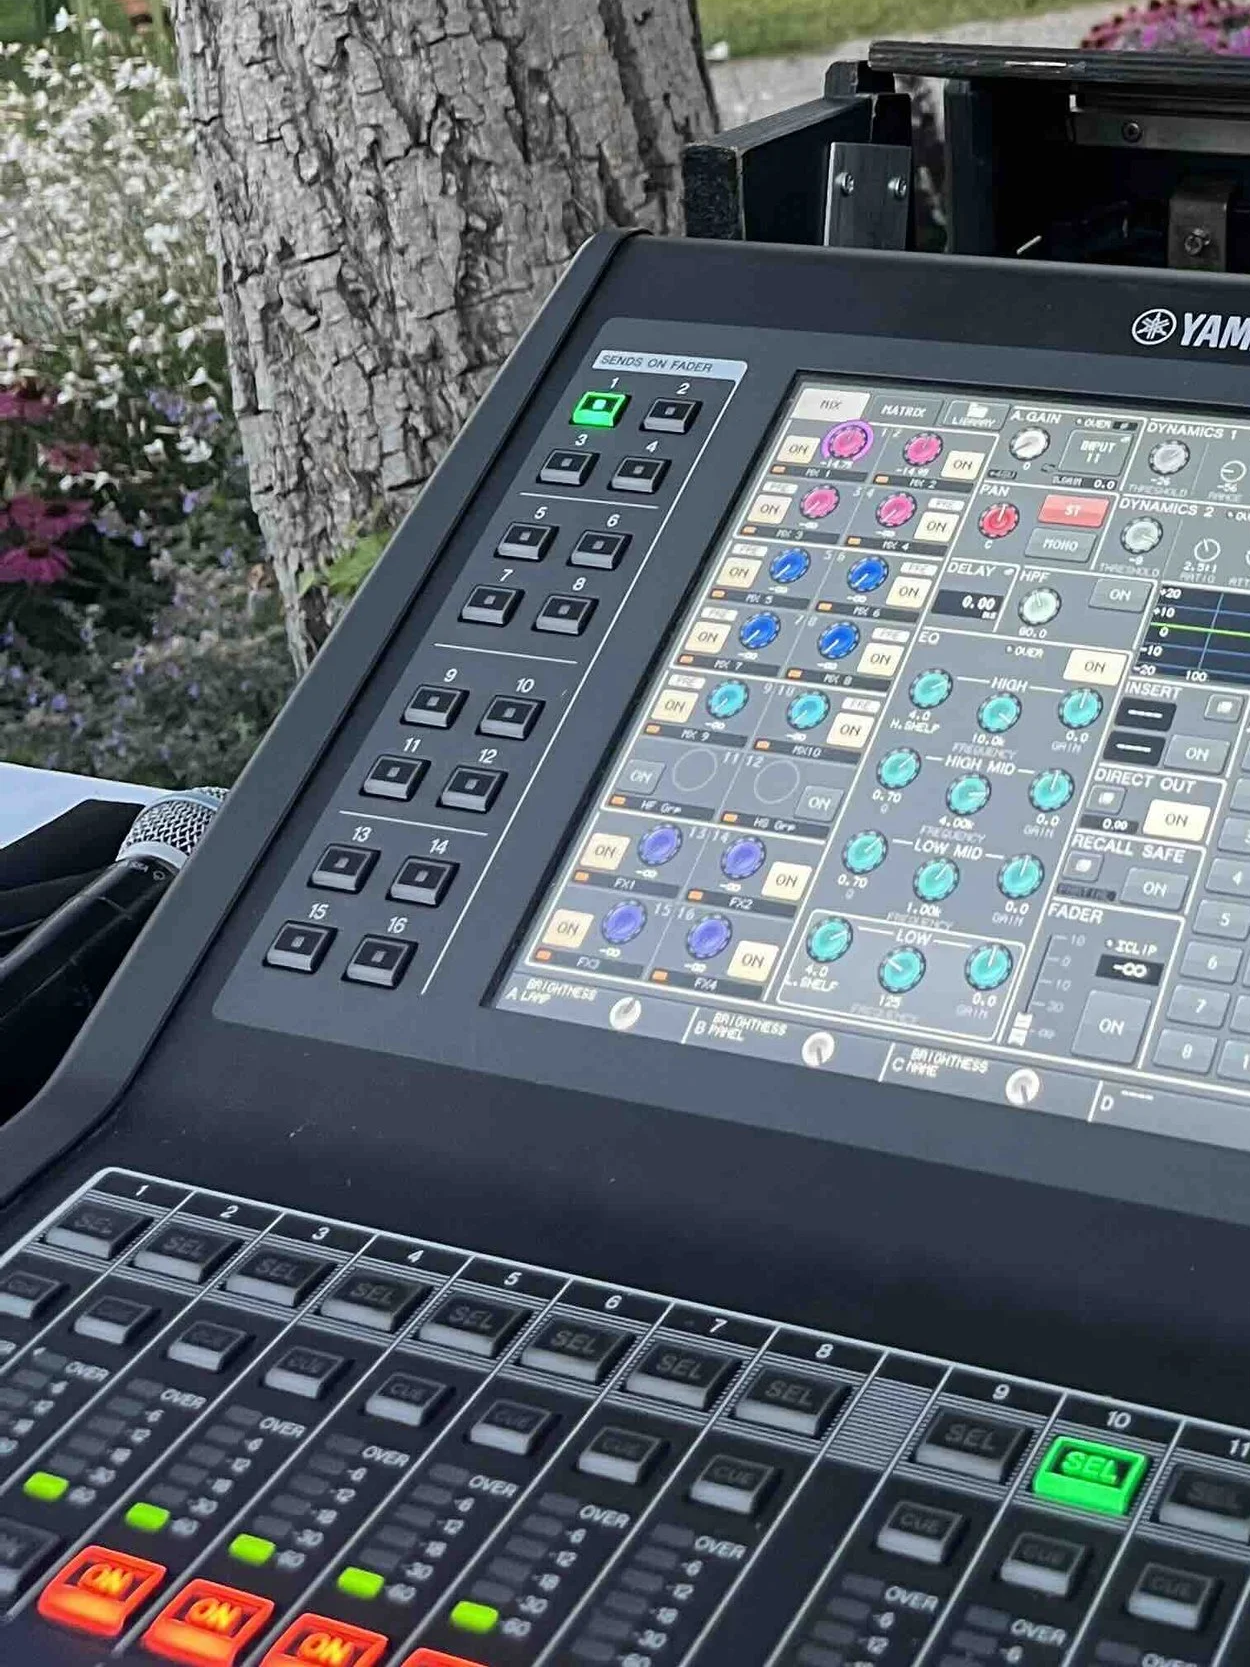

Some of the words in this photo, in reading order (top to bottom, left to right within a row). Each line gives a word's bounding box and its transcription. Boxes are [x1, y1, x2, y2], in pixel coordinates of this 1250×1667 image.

[600, 354, 644, 371] SENDS
[648, 358, 666, 372] ON
[669, 359, 713, 374] FADER
[610, 377, 619, 390] 1
[676, 382, 690, 396] 2
[881, 405, 926, 417] MATRIX
[1147, 422, 1225, 439] DYNAMICS
[1231, 429, 1236, 440] 1
[574, 433, 587, 448] 3
[645, 439, 657, 454] 4
[954, 460, 972, 470] ON
[979, 484, 1010, 497] PAN
[534, 506, 546, 520] 5
[1119, 498, 1198, 516] DYNAMICS
[1204, 508, 1214, 518] 2
[608, 513, 619, 528] 6
[500, 568, 512, 582] 7
[948, 561, 994, 578] DELAY
[1020, 570, 1050, 583] HPF
[572, 576, 586, 591] 8
[1109, 589, 1131, 601] ON
[918, 631, 940, 645] EQ
[444, 668, 457, 682] 9
[1084, 660, 1106, 675] ON
[516, 678, 535, 693] 10
[991, 678, 1029, 694] HIGH
[1125, 681, 1182, 699] INSERT
[404, 737, 423, 752] 11
[478, 747, 497, 763] 12
[944, 755, 982, 773] HIGH
[987, 760, 1017, 777] MID
[1094, 768, 1155, 789] DIRECT
[1161, 777, 1197, 795] OUT
[352, 826, 371, 842] 13
[430, 839, 449, 855] 14
[914, 839, 951, 856] LOW
[954, 844, 983, 861] MID
[1072, 834, 1134, 855] RECALL
[1143, 844, 1186, 864] SAFE
[308, 903, 328, 920] 15
[1048, 903, 1104, 925] FADER
[387, 917, 408, 933] 16
[896, 928, 931, 946] LOW
[1099, 1017, 1123, 1035] ON
[135, 1185, 148, 1196] 1
[221, 1205, 239, 1219] 2
[311, 1226, 330, 1240] 3
[407, 1249, 423, 1264] 4
[504, 1271, 521, 1286] 5
[606, 1296, 620, 1310] 6
[710, 1319, 726, 1333] 7
[816, 1344, 832, 1360] 8
[993, 1384, 1009, 1400] 9
[1107, 1410, 1131, 1428] 10
[1229, 1439, 1250, 1457] 11
[1060, 1449, 1119, 1483] SEL
[580, 1504, 630, 1529] OVER
[82, 1565, 136, 1597] ON
[885, 1584, 938, 1614] OVER
[188, 1598, 243, 1632] ON
[300, 1634, 354, 1665] ON
